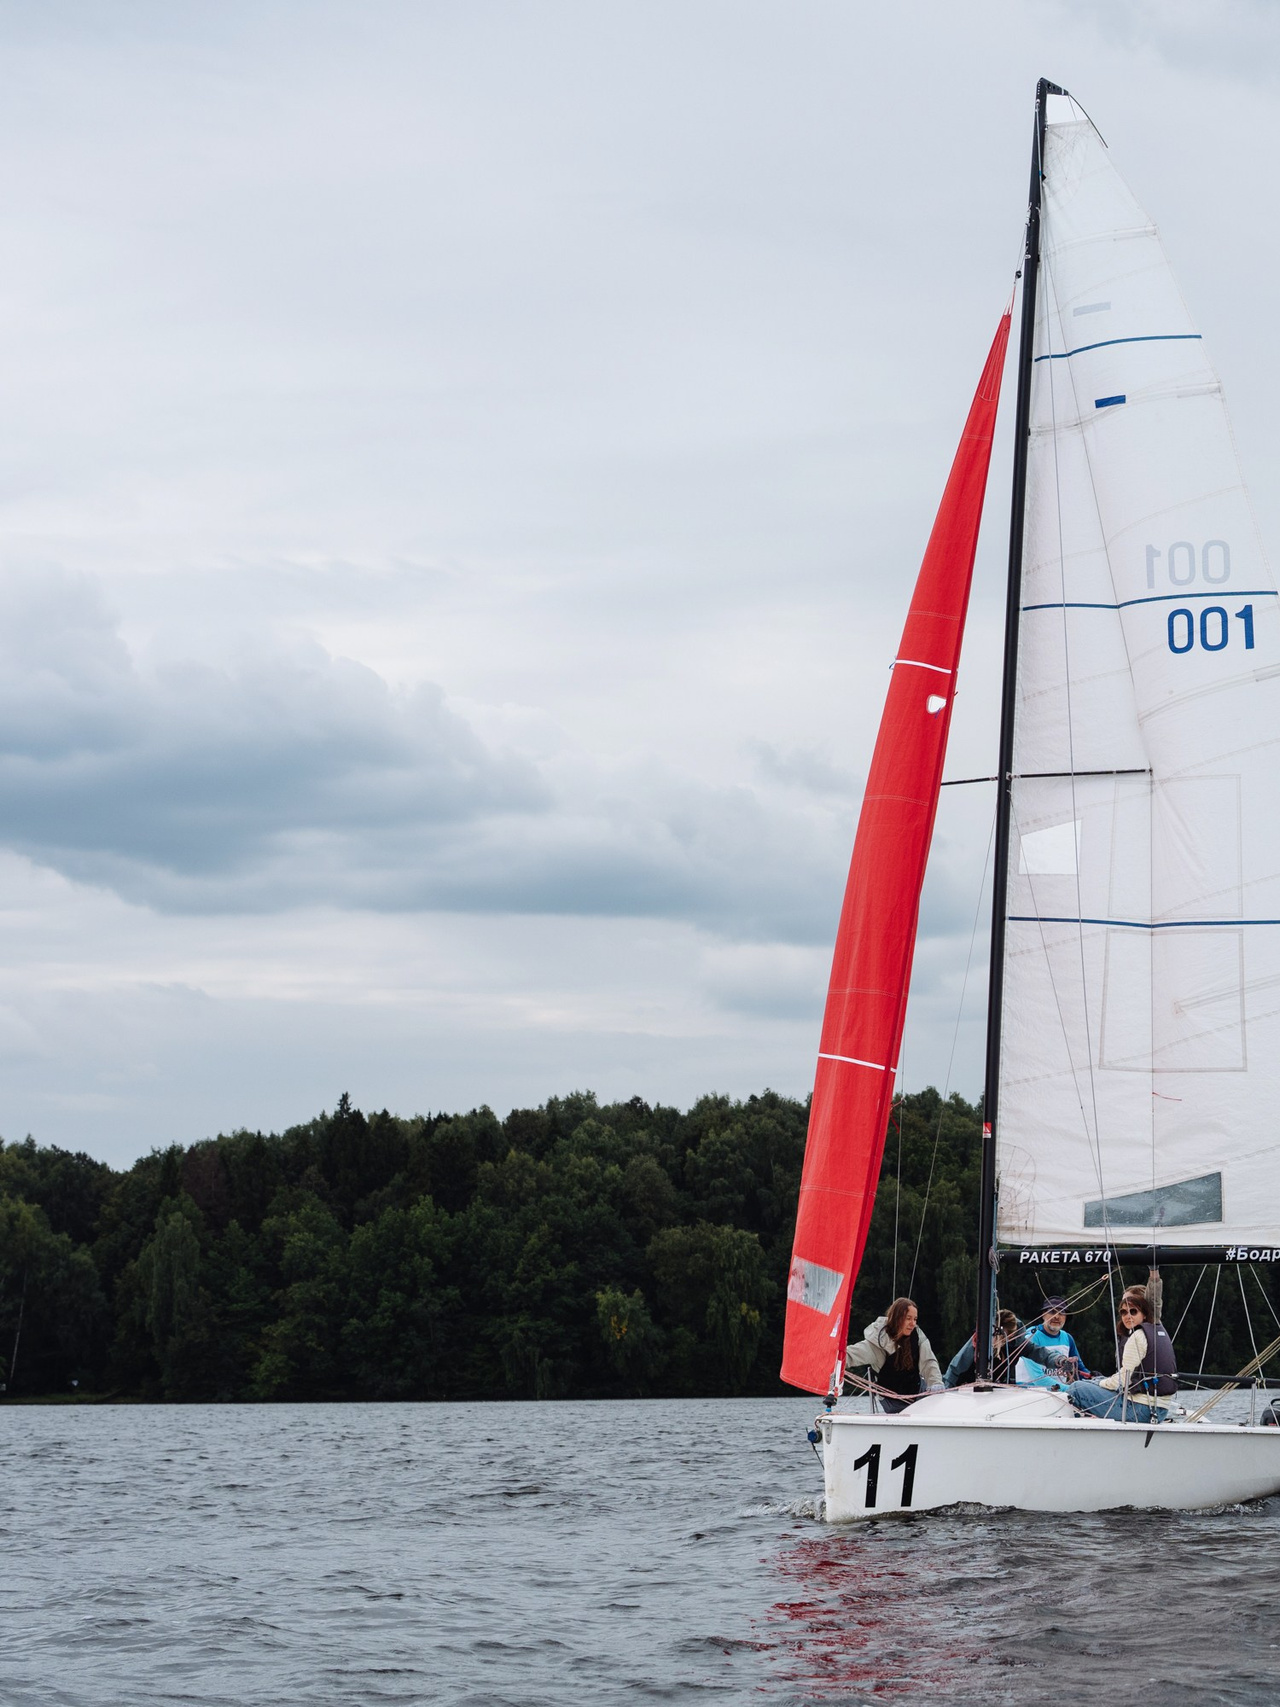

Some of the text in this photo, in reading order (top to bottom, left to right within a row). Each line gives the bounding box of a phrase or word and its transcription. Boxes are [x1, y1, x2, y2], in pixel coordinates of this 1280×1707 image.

[1168, 604, 1255, 654] 001
[1019, 1250, 1112, 1264] РАКЕТА 670
[853, 1444, 918, 1508] 11
